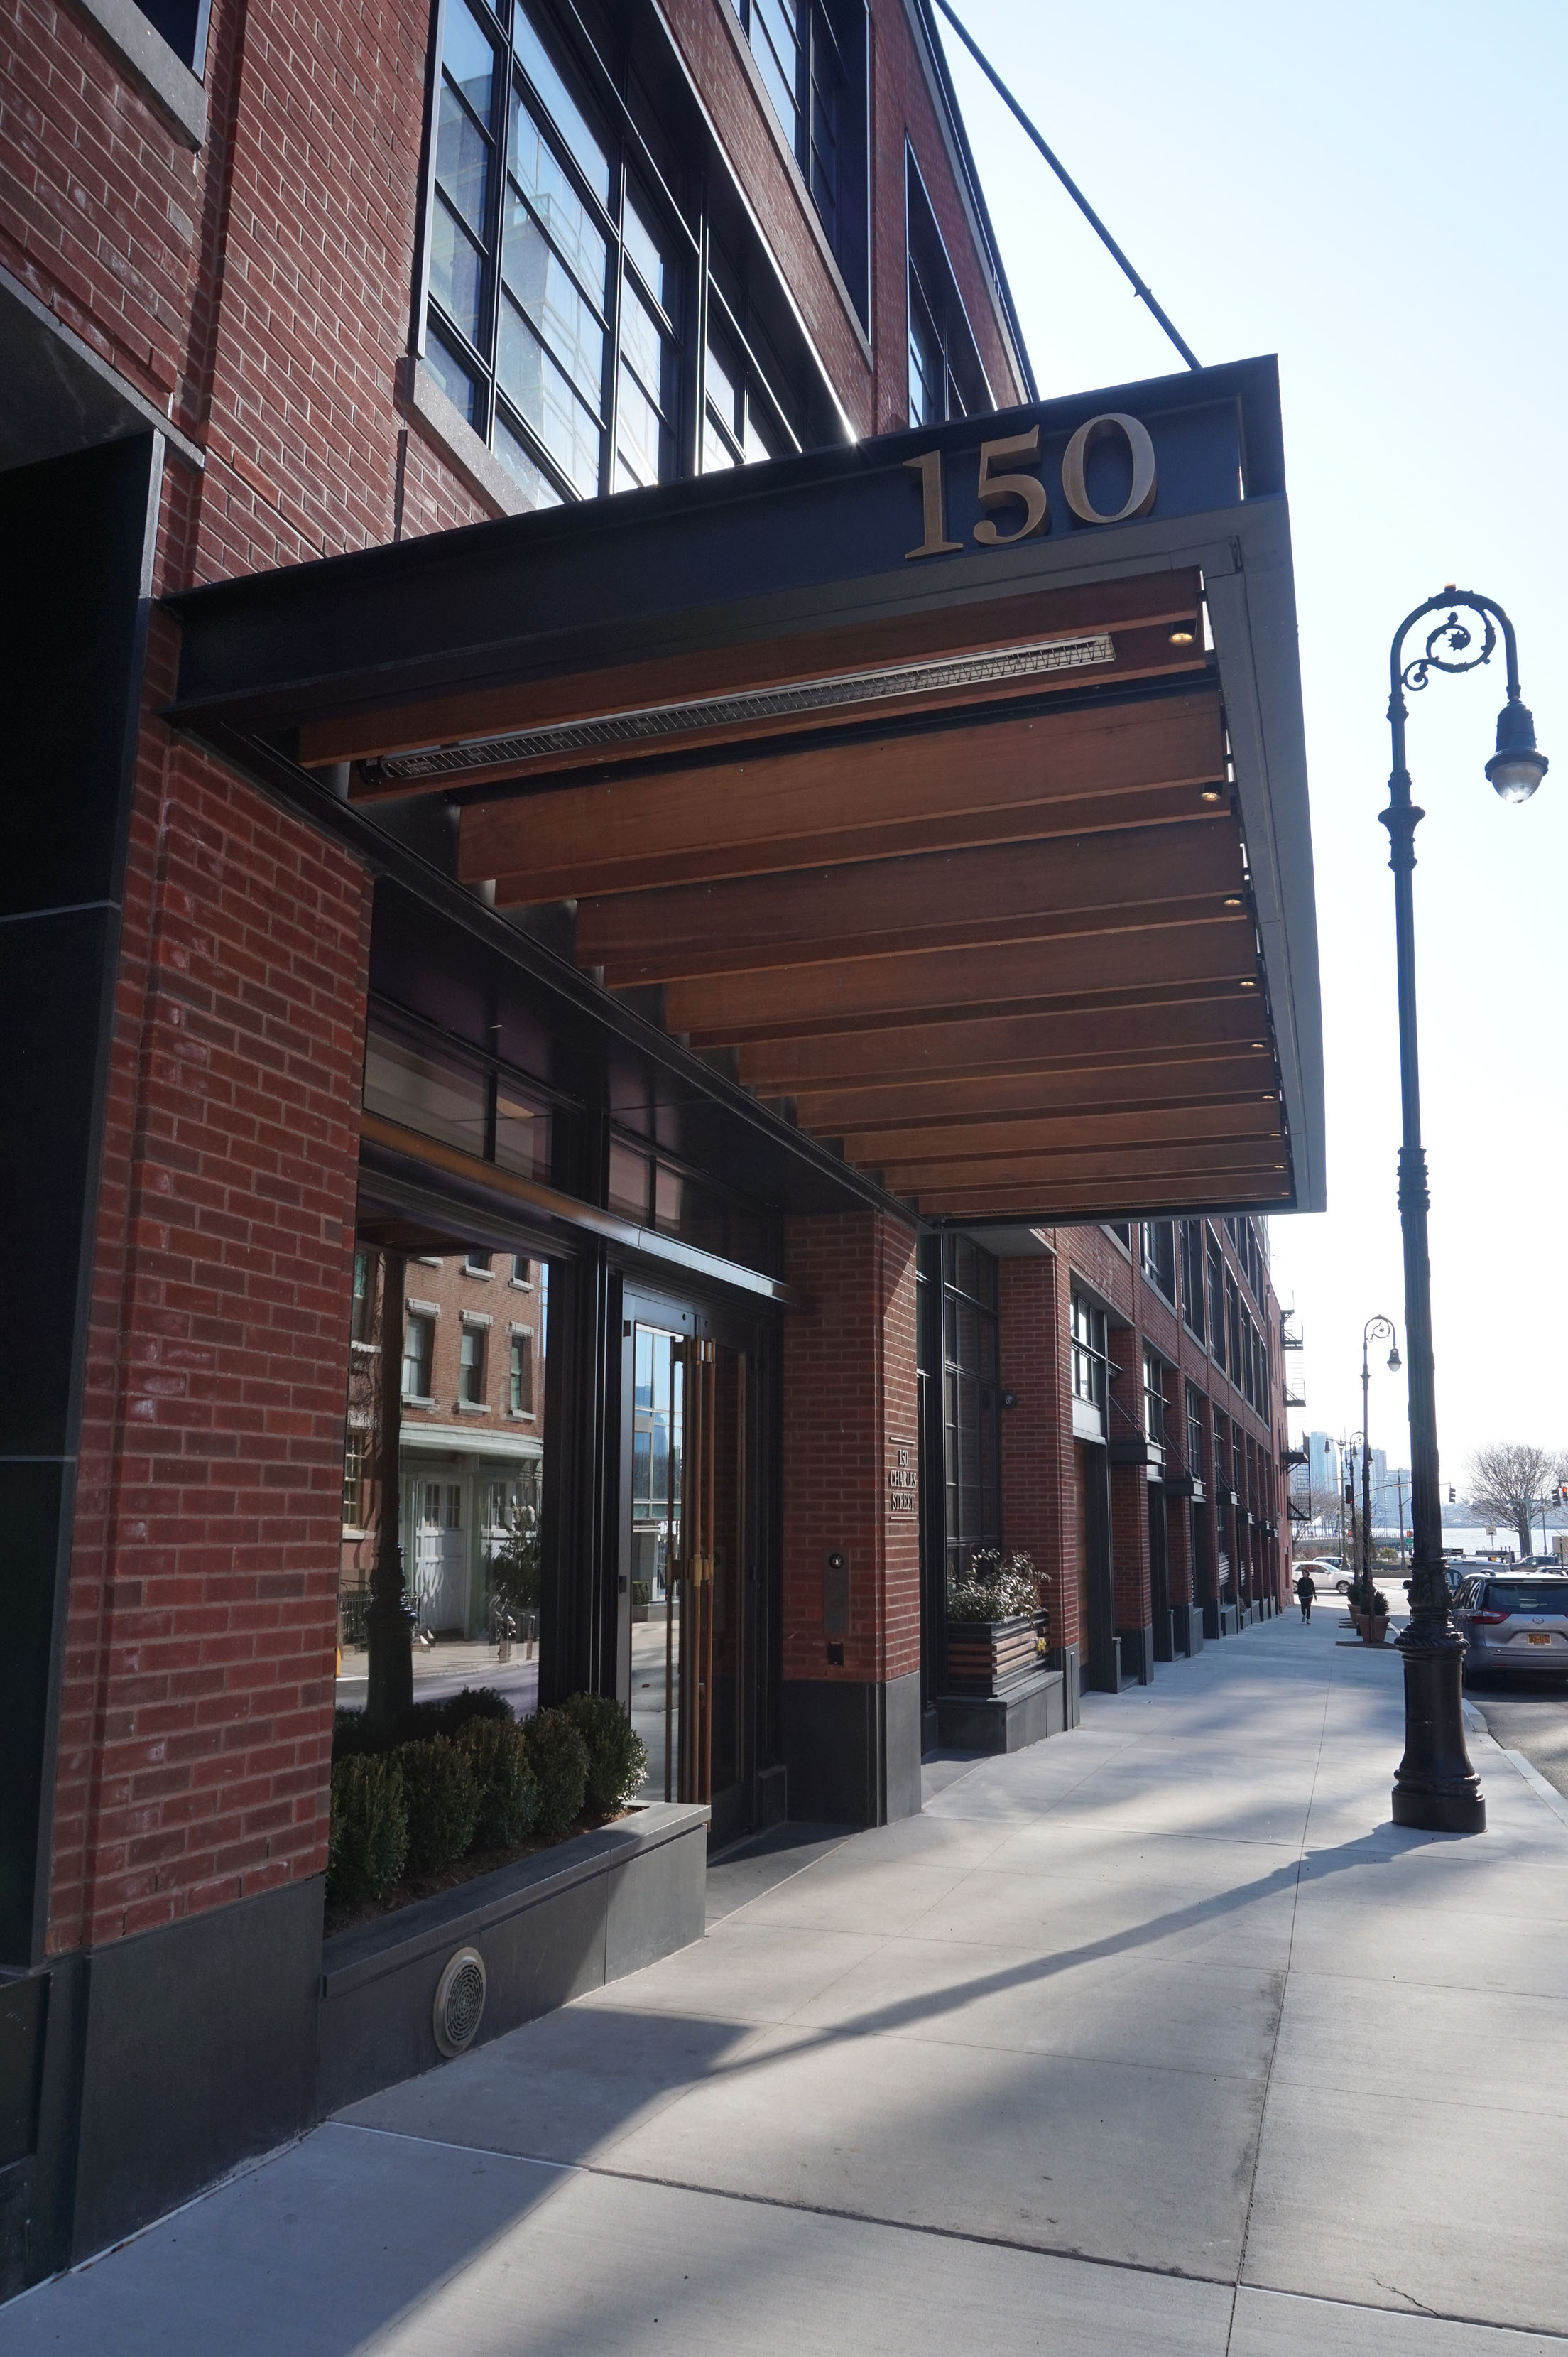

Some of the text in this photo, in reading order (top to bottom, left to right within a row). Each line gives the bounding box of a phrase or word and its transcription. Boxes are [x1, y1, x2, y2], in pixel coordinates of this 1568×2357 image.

[903, 413, 1156, 559] 150
[898, 1449, 909, 1466] 150
[890, 1470, 917, 1488] CHARLES
[893, 1492, 915, 1510] STREET
